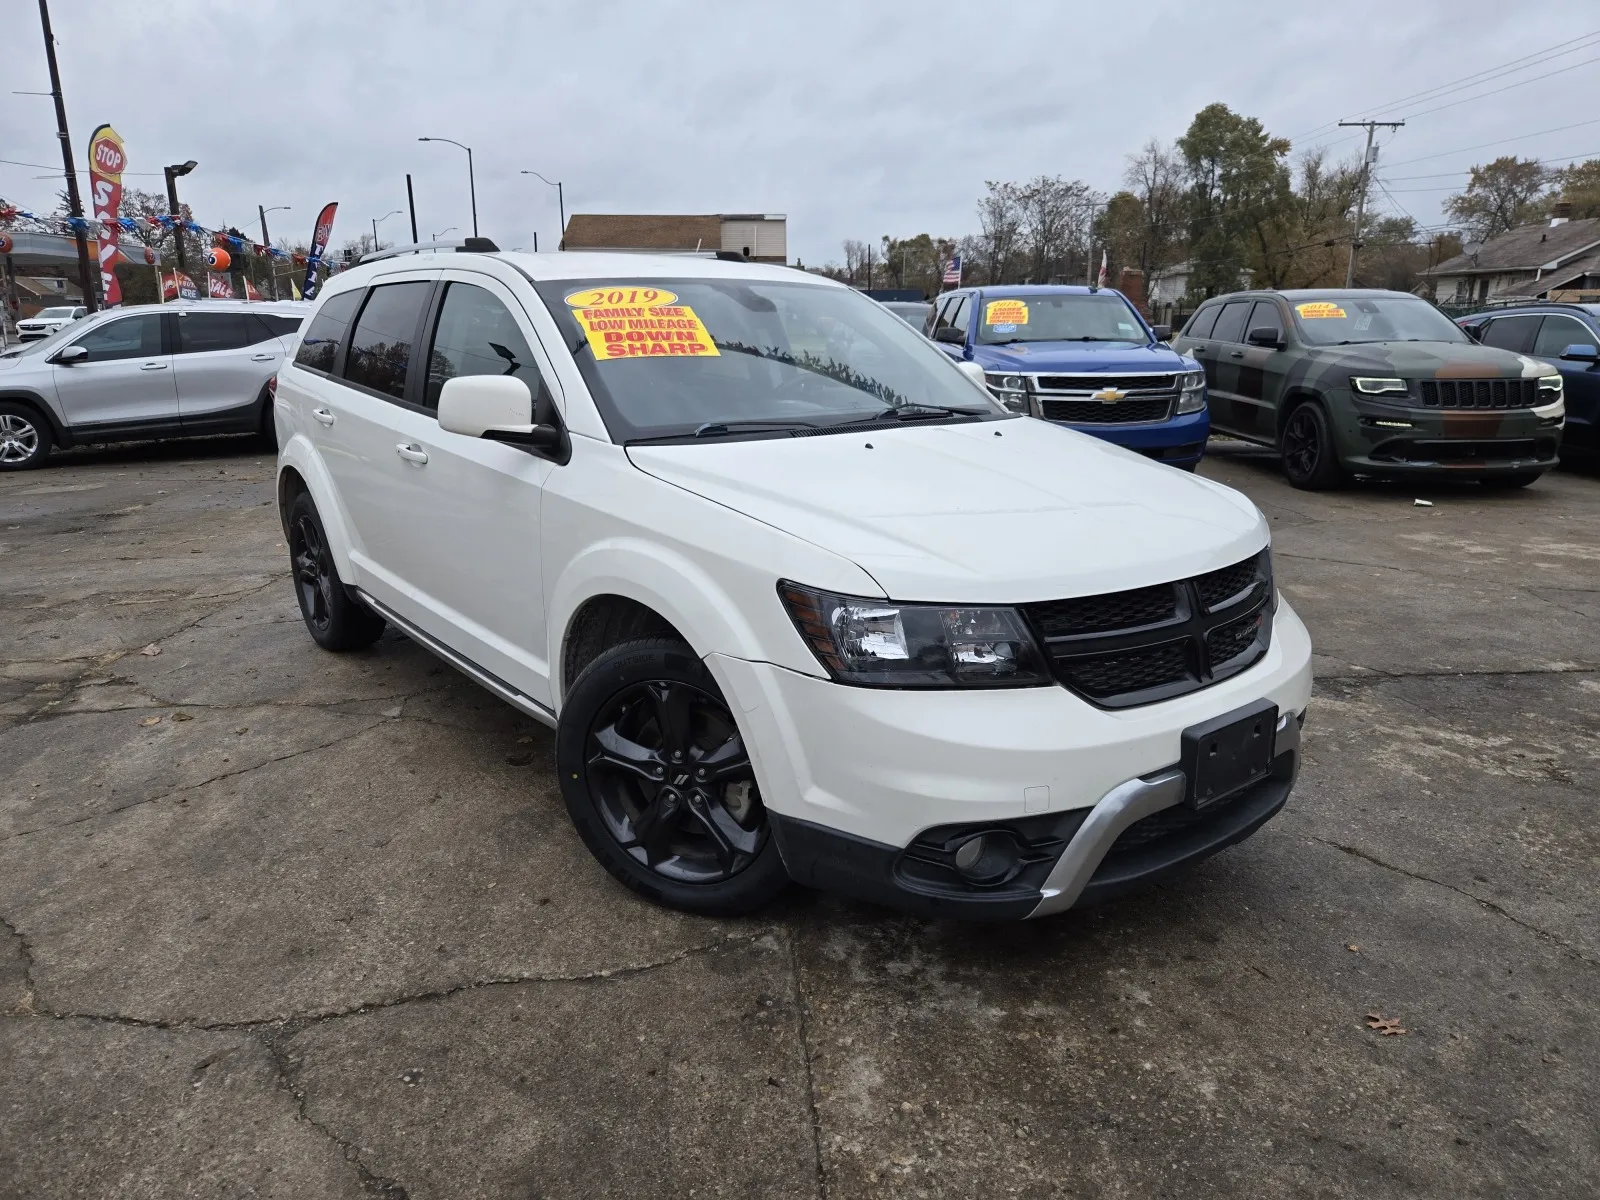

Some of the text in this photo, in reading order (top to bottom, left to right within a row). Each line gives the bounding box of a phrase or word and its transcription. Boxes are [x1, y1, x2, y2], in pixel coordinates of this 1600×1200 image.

[96, 144, 121, 168] STOP
[181, 288, 197, 298] HERE
[209, 278, 233, 298] SALE
[589, 290, 659, 306] 2019
[582, 306, 687, 320] FAMILY SIZE
[589, 319, 699, 332] LOW MILEAGE
[604, 331, 697, 343] DOWN
[606, 343, 708, 357] SHARP
[613, 653, 656, 669] OUTSIDE
